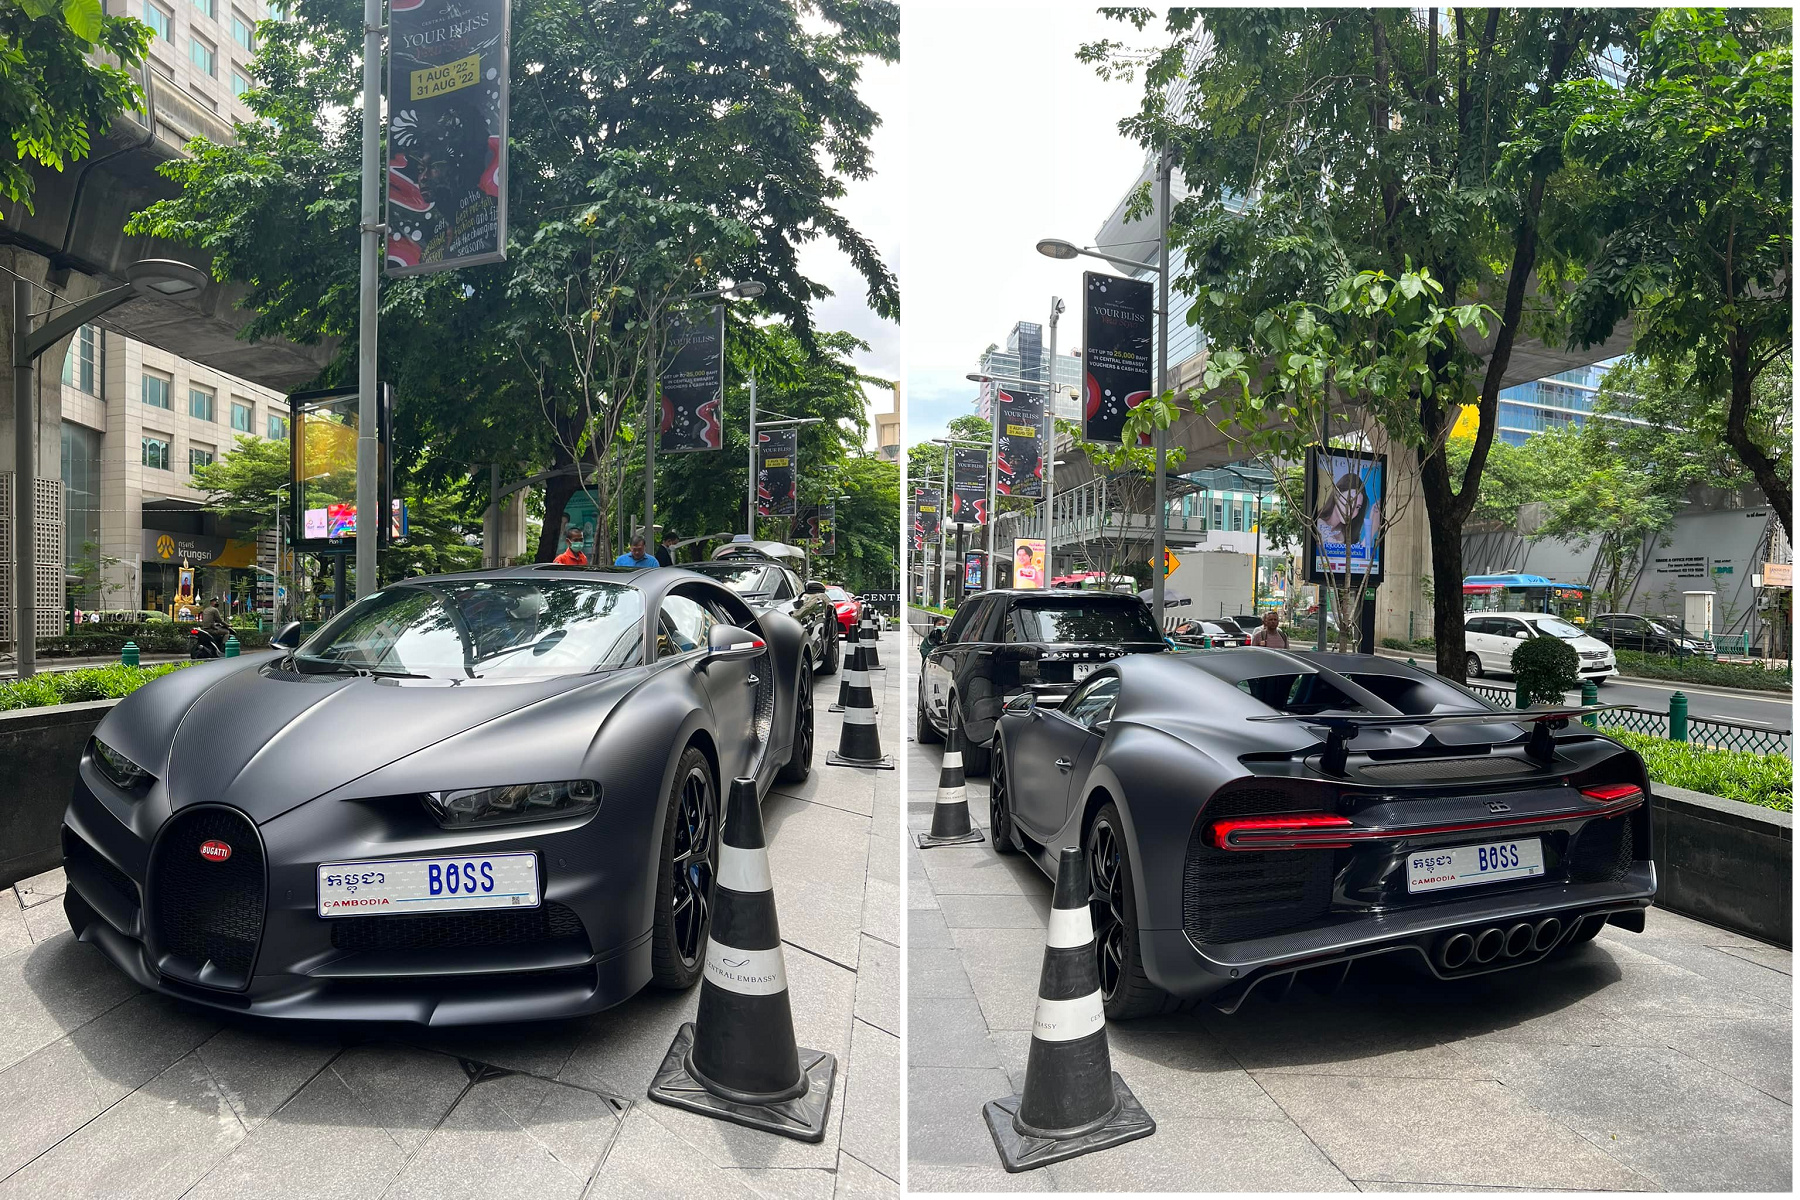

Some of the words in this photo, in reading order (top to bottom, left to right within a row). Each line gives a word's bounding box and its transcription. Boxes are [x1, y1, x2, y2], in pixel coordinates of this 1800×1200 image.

[402, 28, 446, 48] YOUR
[449, 12, 489, 39] BLISS
[418, 74, 422, 83] 1
[427, 68, 450, 82] AUG
[453, 62, 468, 74] '22
[417, 85, 428, 95] 31
[432, 78, 456, 92] AUG
[459, 72, 474, 84] '22
[468, 191, 480, 203] the
[476, 208, 488, 224] and
[462, 232, 470, 243] the
[471, 222, 497, 239] changing
[458, 238, 485, 257] seasons
[1094, 306, 1120, 319] YOUR
[1121, 311, 1145, 322] BLISS
[693, 335, 715, 344] BLISS
[1114, 350, 1135, 359] 25,000
[1089, 361, 1115, 369] VOUCHERS
[1004, 410, 1021, 418] YOUR
[178, 548, 212, 560] krungsri
[203, 846, 227, 857] BUGATTI
[1411, 875, 1456, 886] CAMBODIA
[324, 898, 390, 908] CAMBODIA
[706, 959, 735, 980] CENTRAL
[737, 974, 777, 983] EMBASSY
